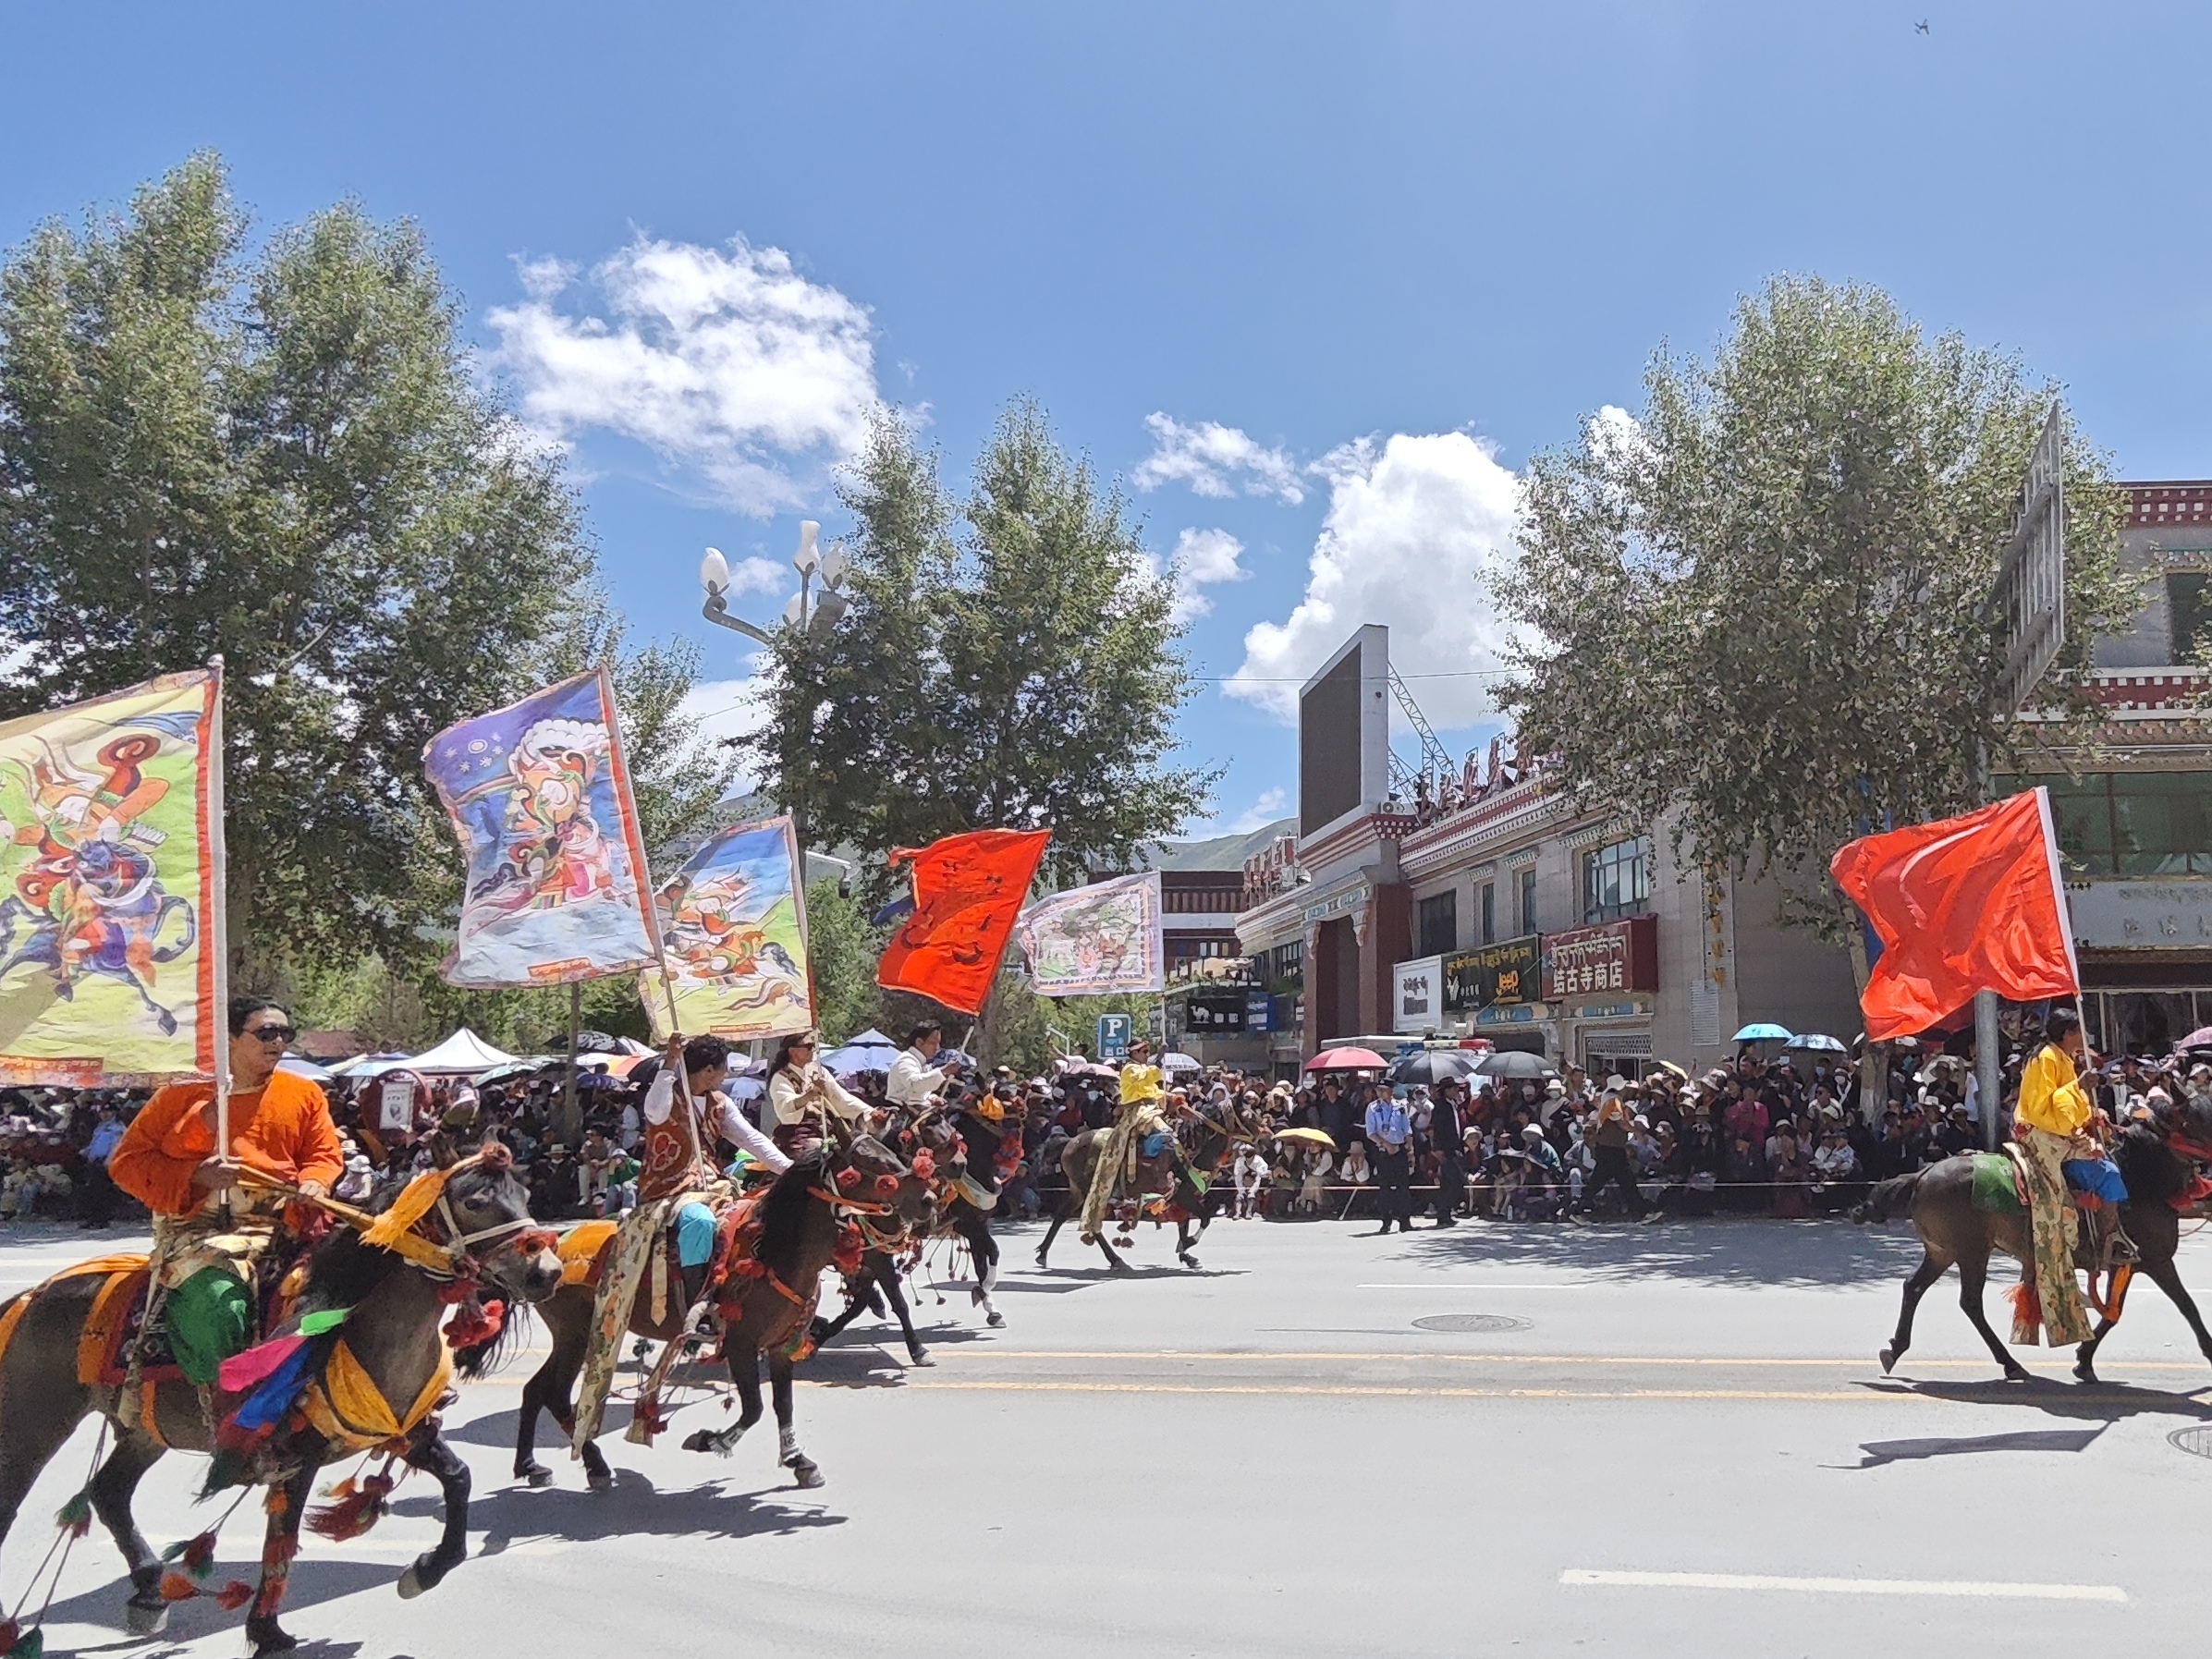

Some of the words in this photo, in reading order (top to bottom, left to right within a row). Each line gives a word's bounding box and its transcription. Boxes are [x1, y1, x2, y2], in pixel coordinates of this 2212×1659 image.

[1496, 970, 1519, 996] Jeep
[1553, 958, 1623, 994] 结古寺商店
[1106, 1019, 1123, 1037] P
